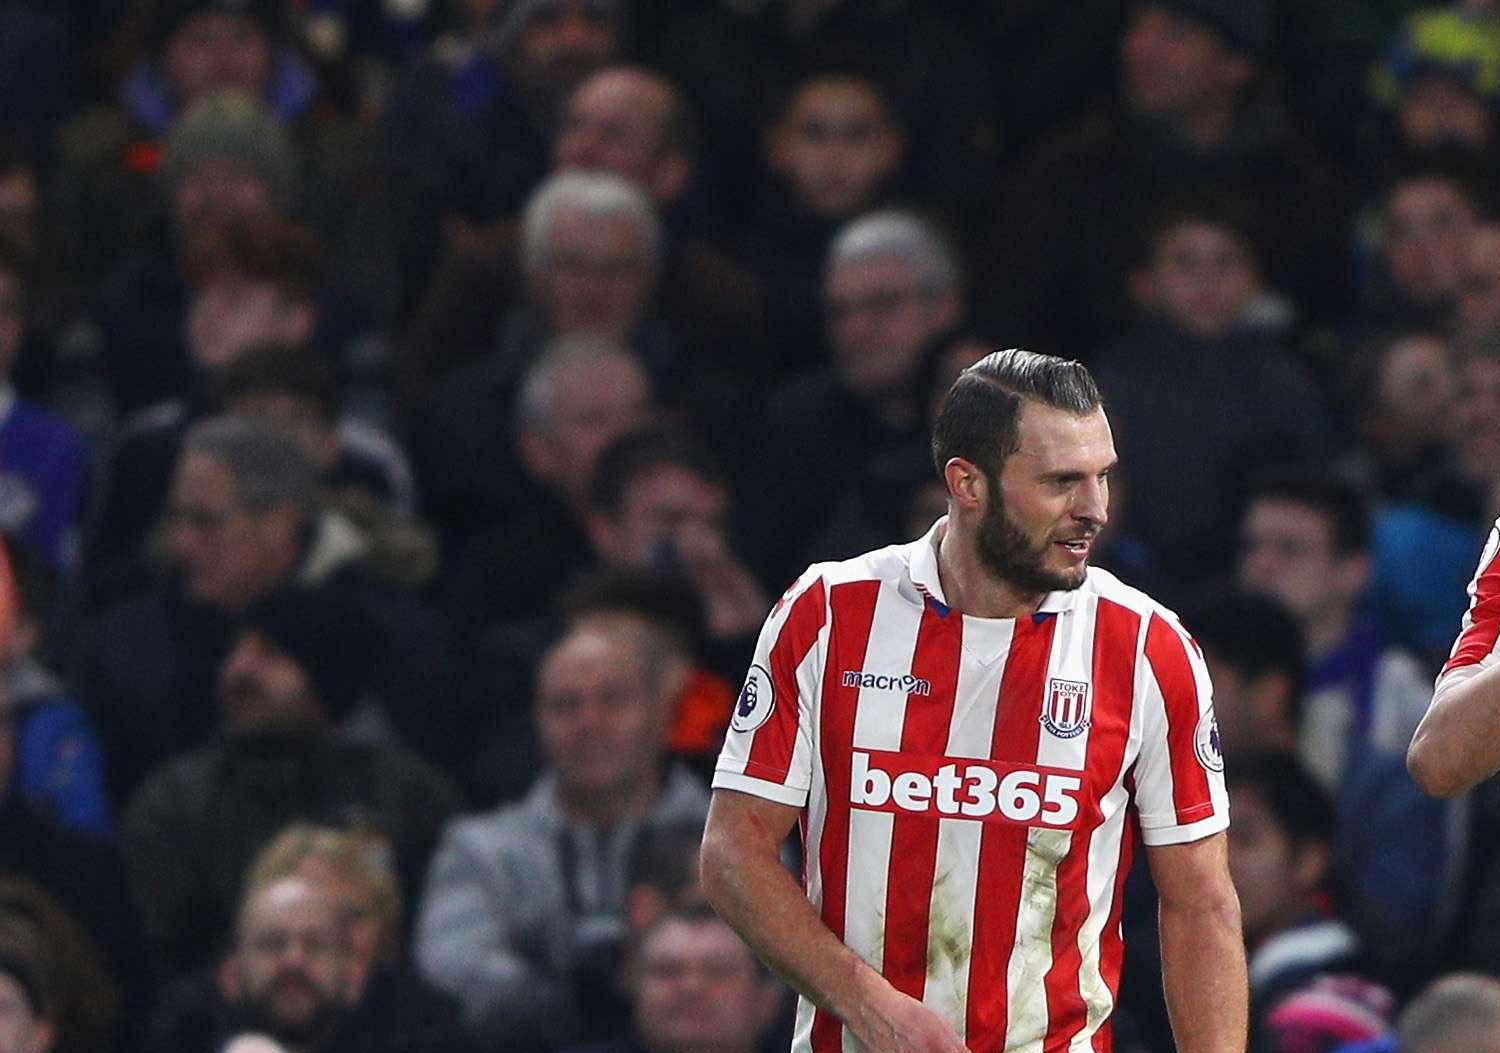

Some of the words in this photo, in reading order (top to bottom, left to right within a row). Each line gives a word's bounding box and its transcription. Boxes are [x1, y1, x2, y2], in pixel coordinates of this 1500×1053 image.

[842, 671, 931, 696] macron
[1052, 682, 1085, 693] STOKE
[850, 752, 1081, 826] bet365
